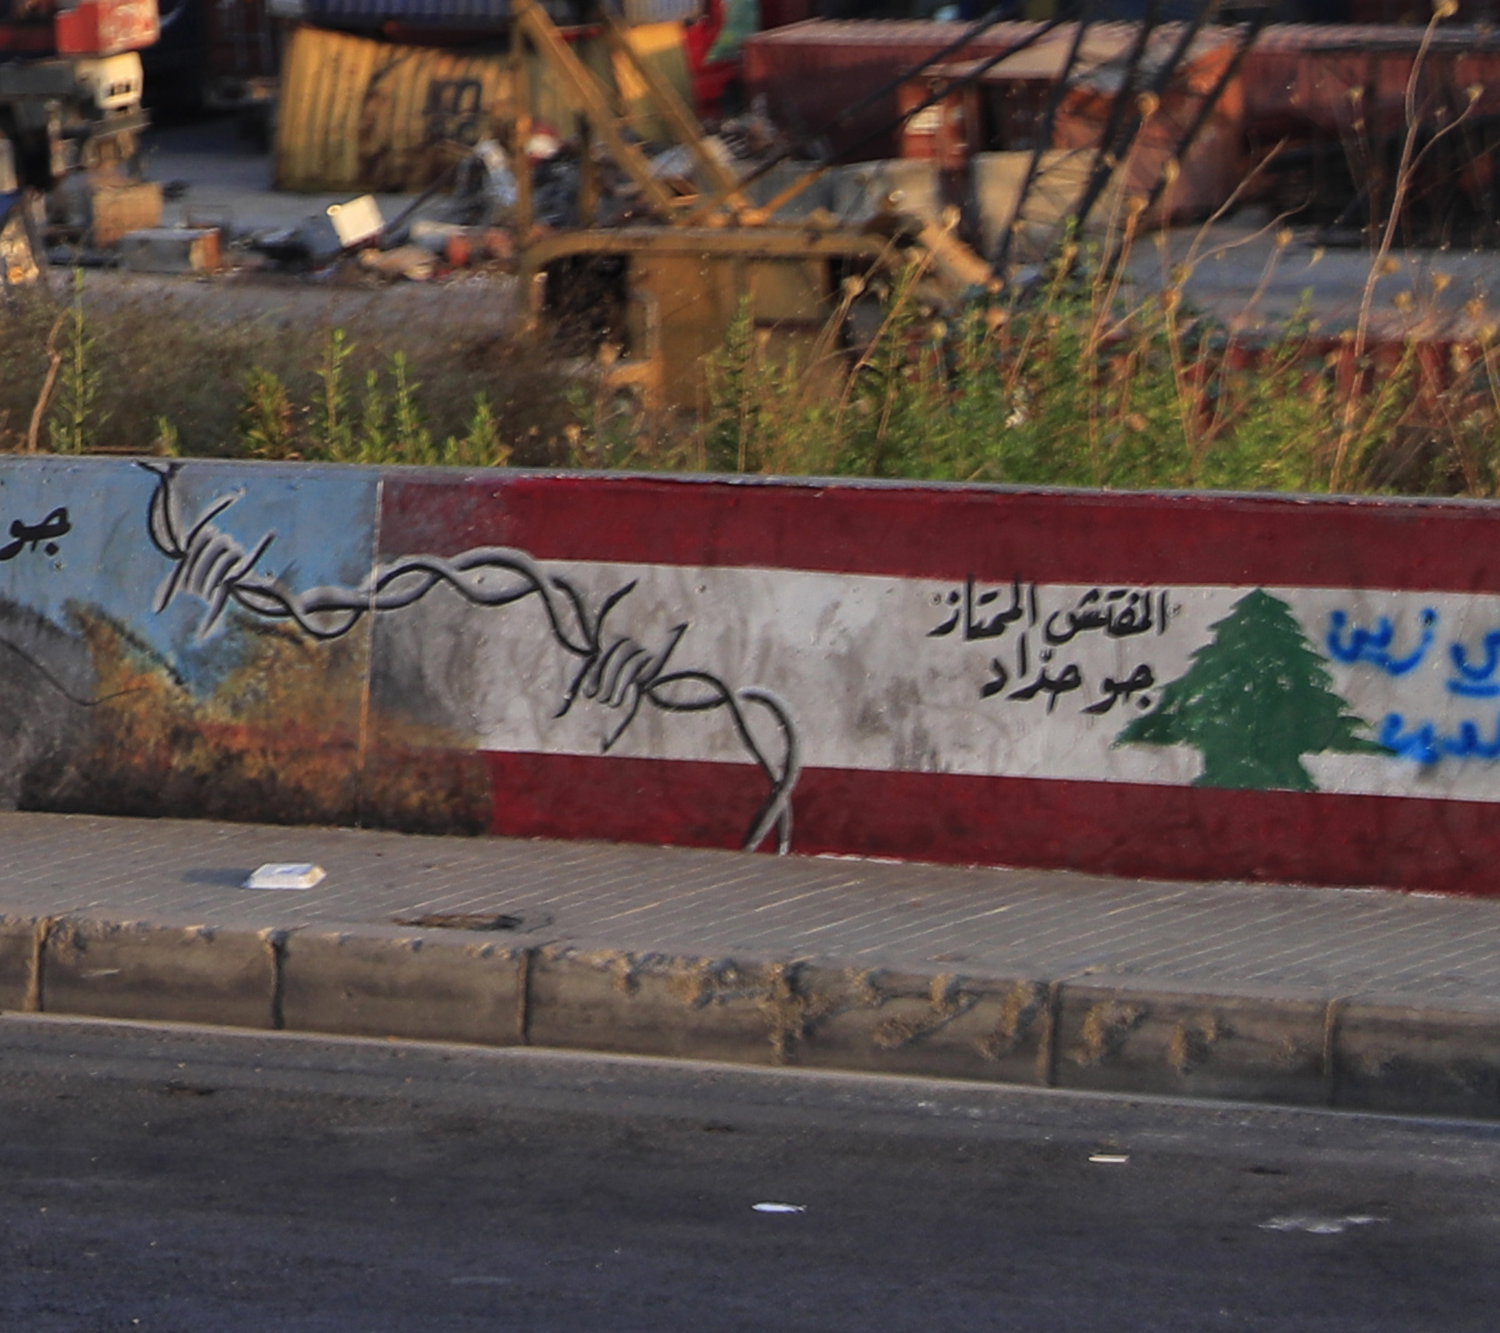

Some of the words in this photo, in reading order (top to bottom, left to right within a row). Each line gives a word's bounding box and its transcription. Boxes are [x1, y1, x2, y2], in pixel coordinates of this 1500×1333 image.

[926, 573, 1037, 641] الممتاز
[1043, 587, 1168, 646] المفتش
[1325, 607, 1439, 678] زين
[1080, 662, 1156, 716] جو
